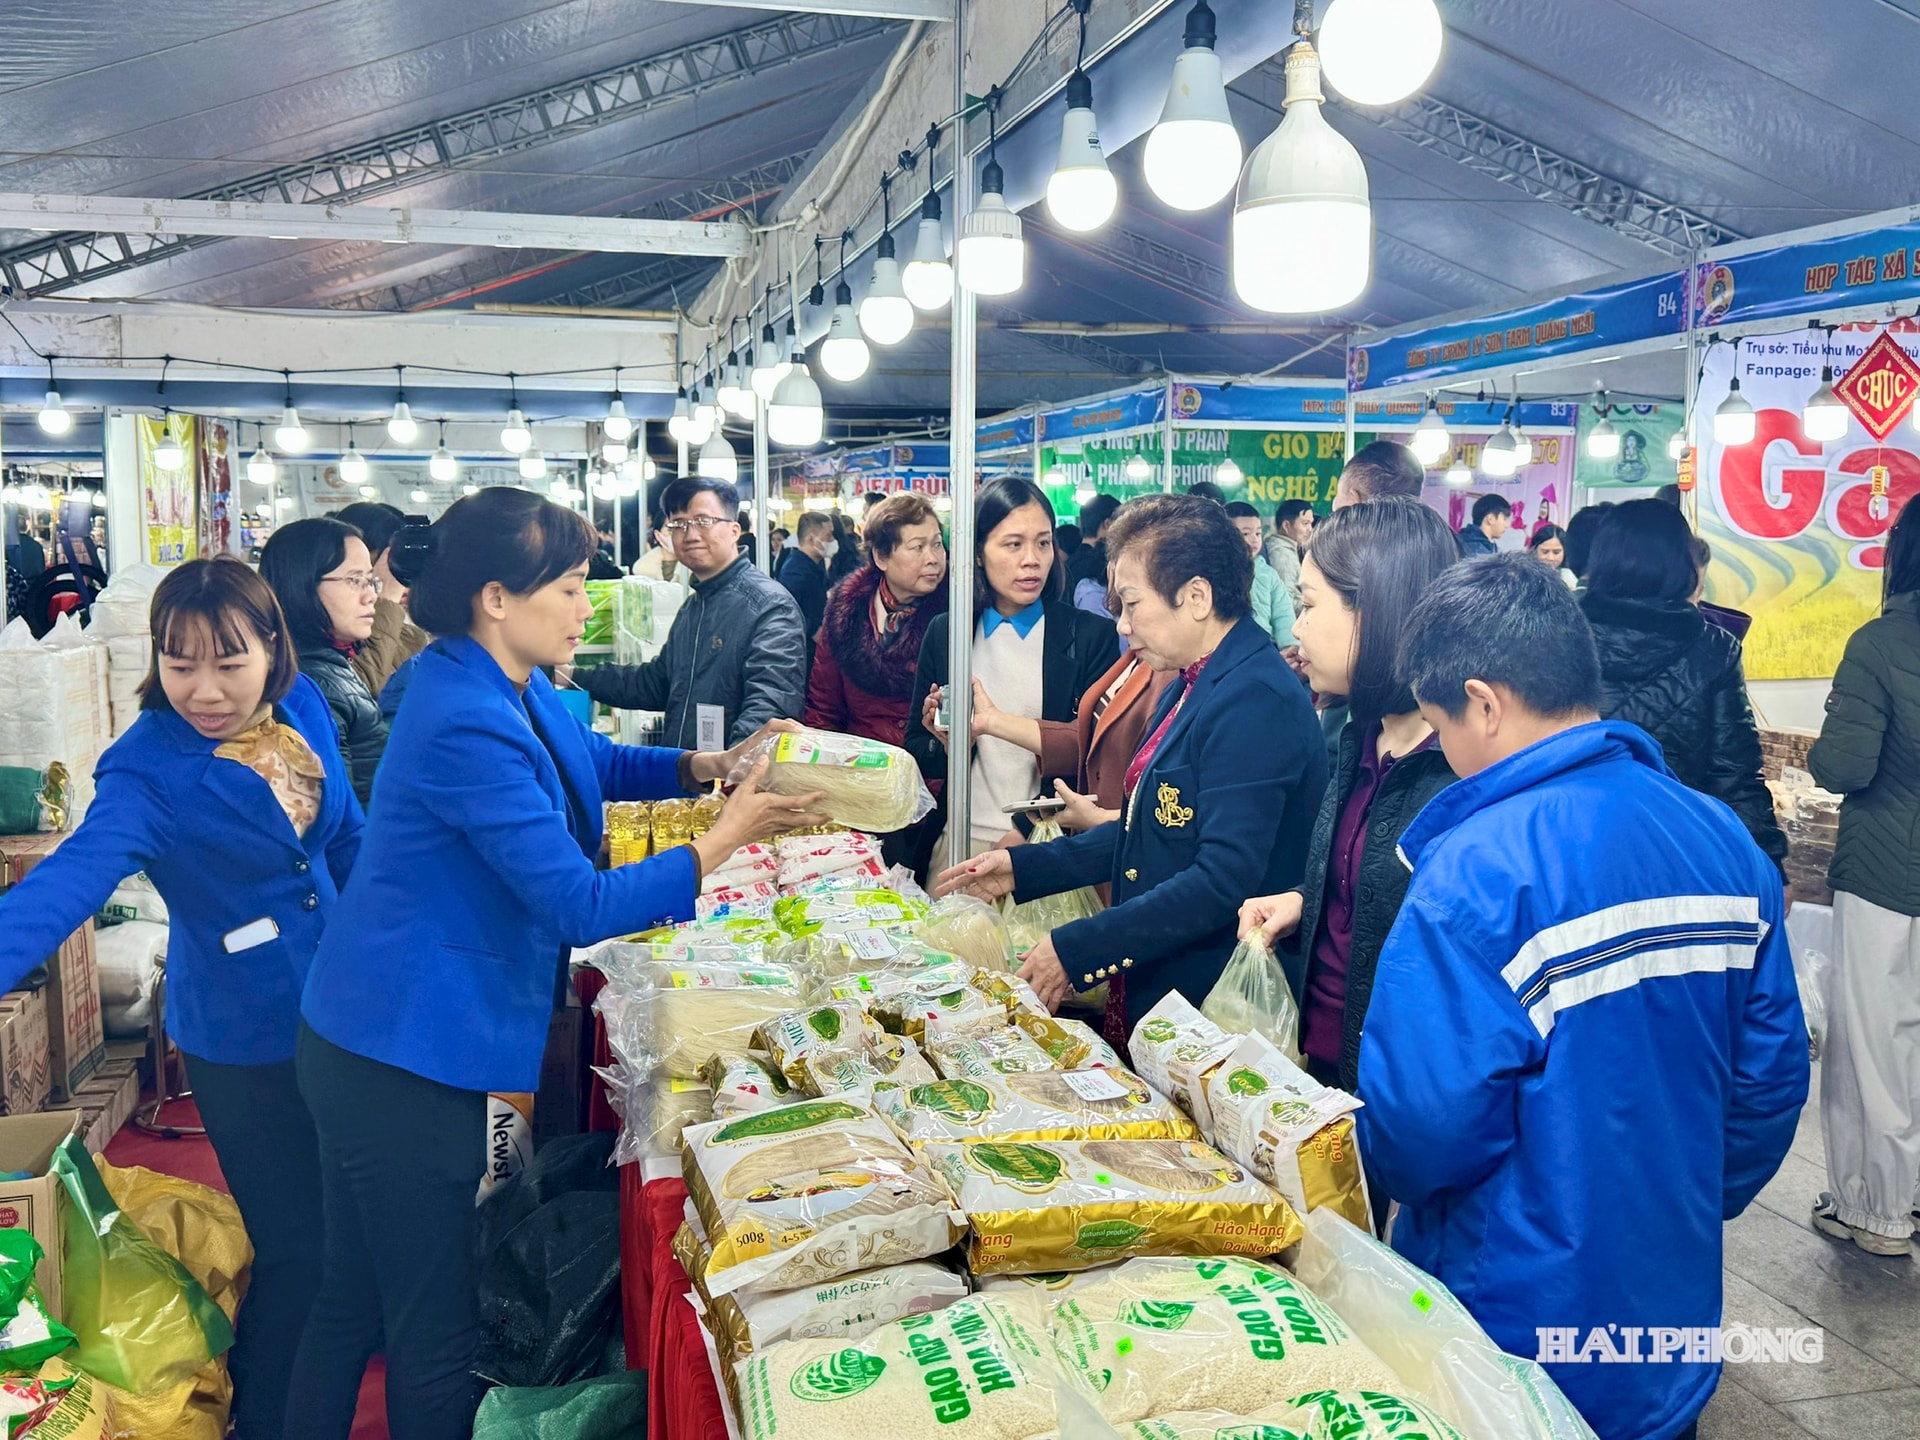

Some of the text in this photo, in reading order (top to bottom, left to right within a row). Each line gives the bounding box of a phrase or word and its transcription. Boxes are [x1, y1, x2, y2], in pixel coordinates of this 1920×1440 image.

[1804, 263, 1838, 293] HỢP
[1844, 254, 1877, 286] TÁC
[1881, 247, 1906, 280] XÃ
[1657, 291, 1677, 318] 84
[1506, 325, 1532, 348] FARM
[1745, 342, 1765, 356] Trụ
[1769, 342, 1788, 354] sở:
[1792, 340, 1818, 355] Tiểu
[1821, 343, 1842, 356] khu
[1746, 363, 1816, 379] Fanpage:
[1857, 360, 1908, 411] CHÚC
[1302, 399, 1325, 413] HTX
[1550, 402, 1566, 417] 83
[735, 1231, 765, 1249] 500g
[1080, 1227, 1135, 1240] Natural products
[1213, 1220, 1286, 1241] Hảo Hạng
[979, 1252, 1006, 1265] gon
[1275, 1295, 1328, 1346] HOA
[1236, 1308, 1287, 1361] GẠO
[966, 1346, 1017, 1395] HOA
[924, 1365, 972, 1424] GẠO
